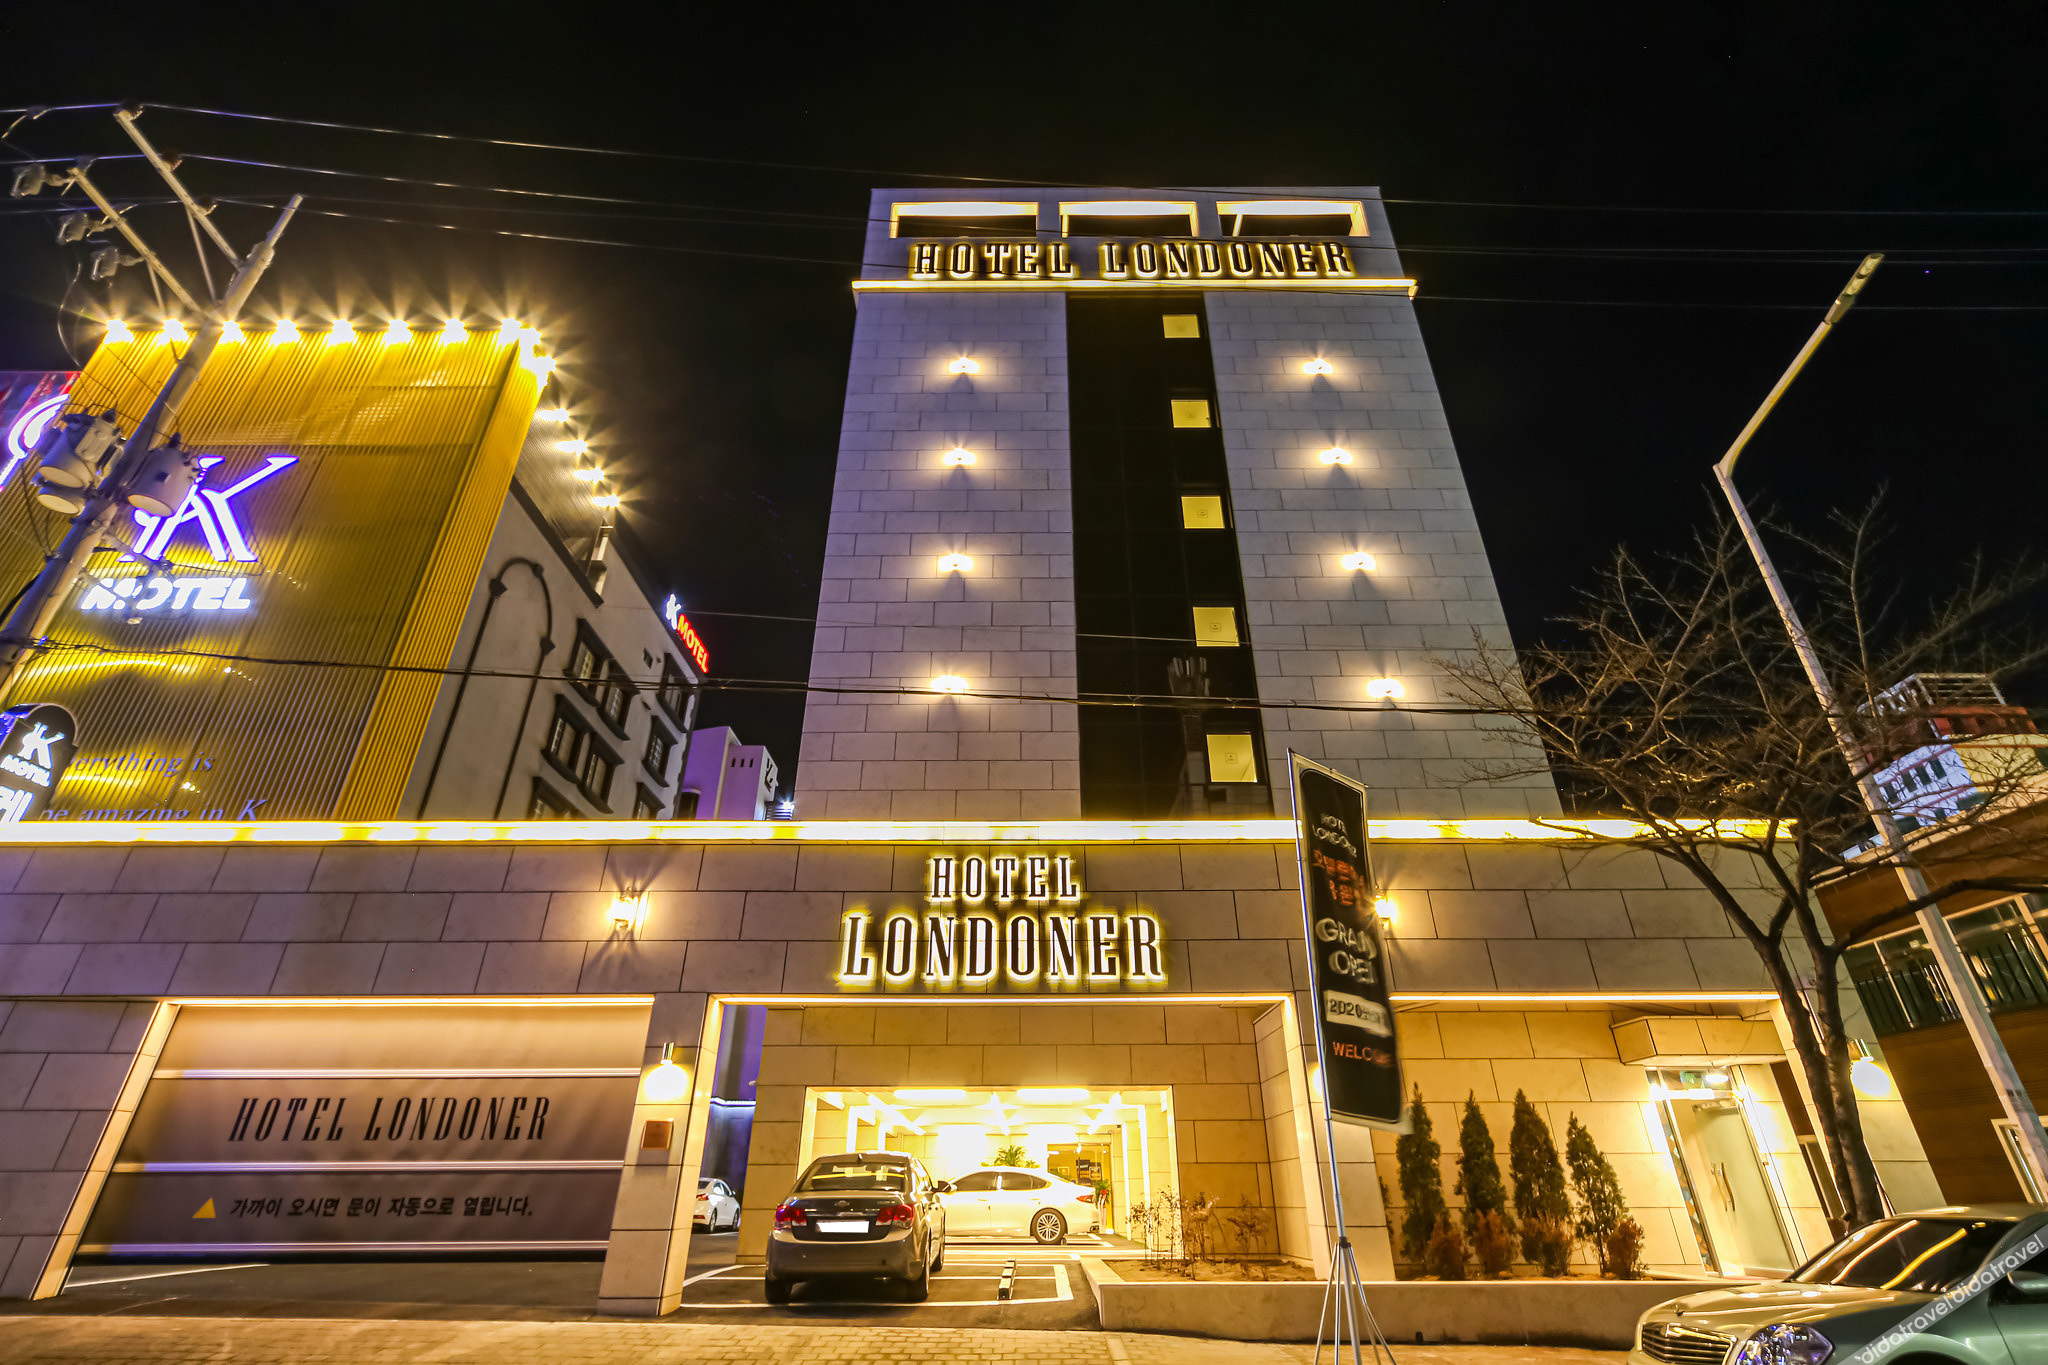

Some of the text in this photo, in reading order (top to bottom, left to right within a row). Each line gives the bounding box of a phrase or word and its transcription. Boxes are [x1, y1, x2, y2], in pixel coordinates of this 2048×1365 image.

[911, 241, 1355, 278] HOTEL LONDONER
[677, 613, 709, 674] MOTEL
[68, 752, 214, 777] erything is
[80, 803, 189, 821] amazing
[200, 803, 224, 821] in
[237, 799, 267, 821] K
[931, 856, 1078, 899] HOTEL
[842, 916, 1163, 978] LONDONER
[1332, 1041, 1395, 1067] WELC
[228, 1096, 551, 1142] HOTEL LONDONER
[230, 1197, 534, 1218] 가까이 오시면 문이 자동으로 열립니다.
